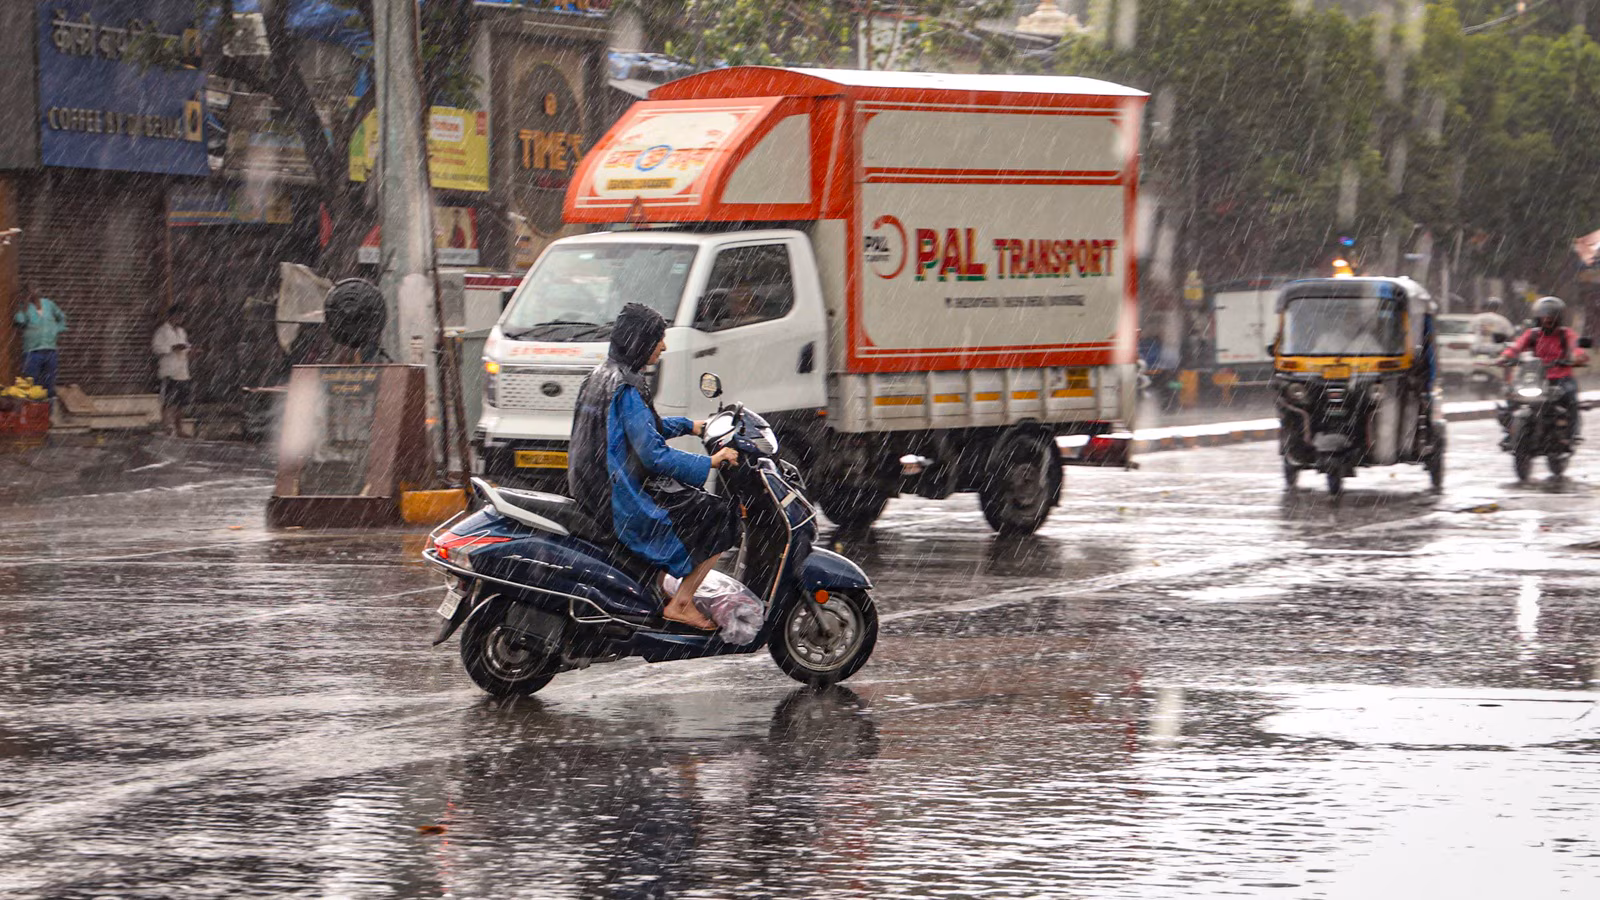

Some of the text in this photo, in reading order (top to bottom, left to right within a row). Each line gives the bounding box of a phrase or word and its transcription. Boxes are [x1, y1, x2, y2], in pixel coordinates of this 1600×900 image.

[49, 106, 102, 133] COFFEE
[914, 227, 1118, 281] PAL TRANSPORT
